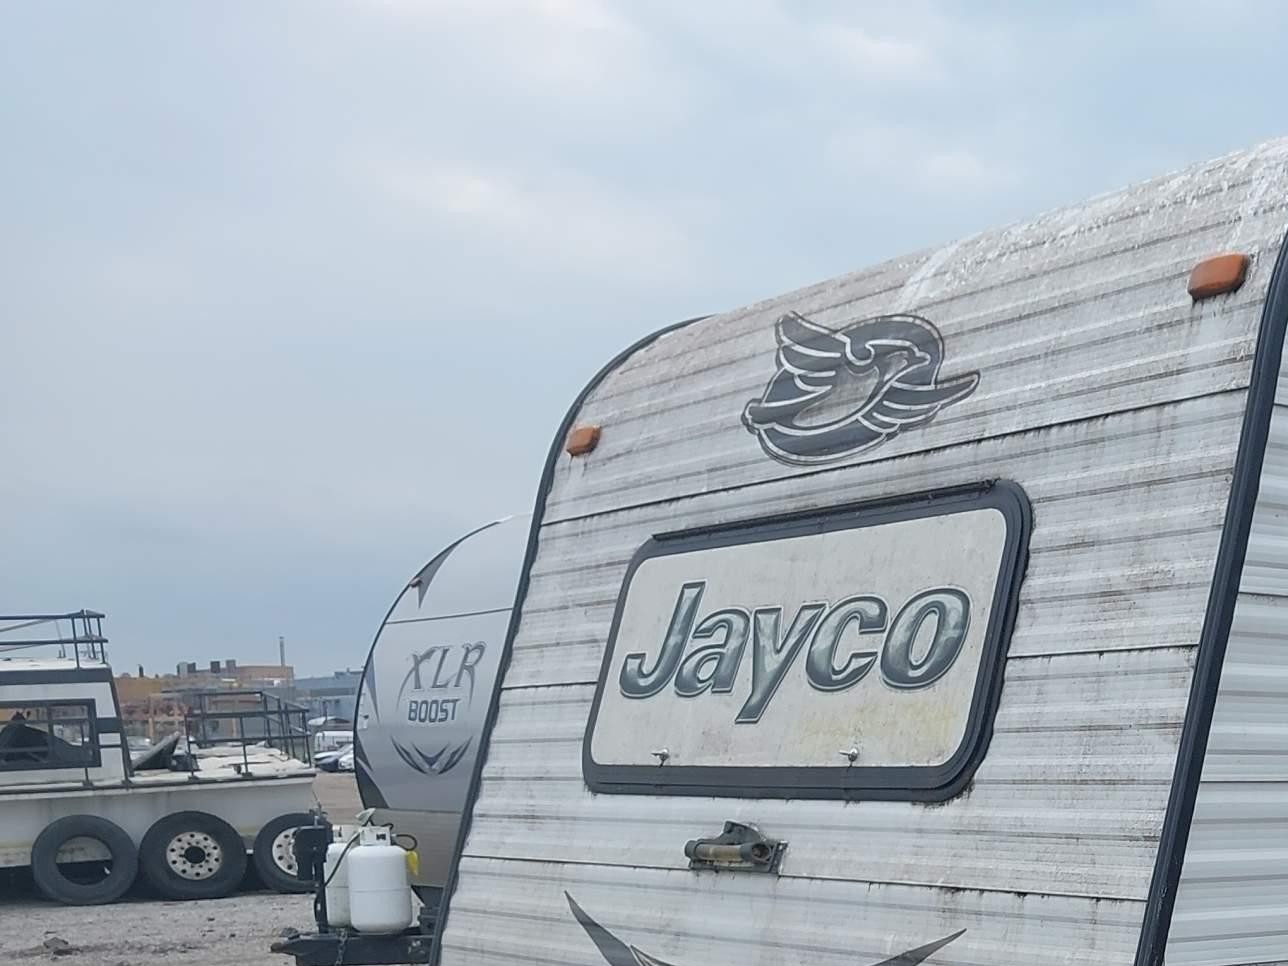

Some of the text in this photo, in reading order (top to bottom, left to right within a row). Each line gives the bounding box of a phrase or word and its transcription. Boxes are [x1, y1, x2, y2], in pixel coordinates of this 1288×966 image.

[398, 641, 486, 709] XLR
[619, 579, 971, 724] Jayco
[408, 699, 461, 722] BOOST
